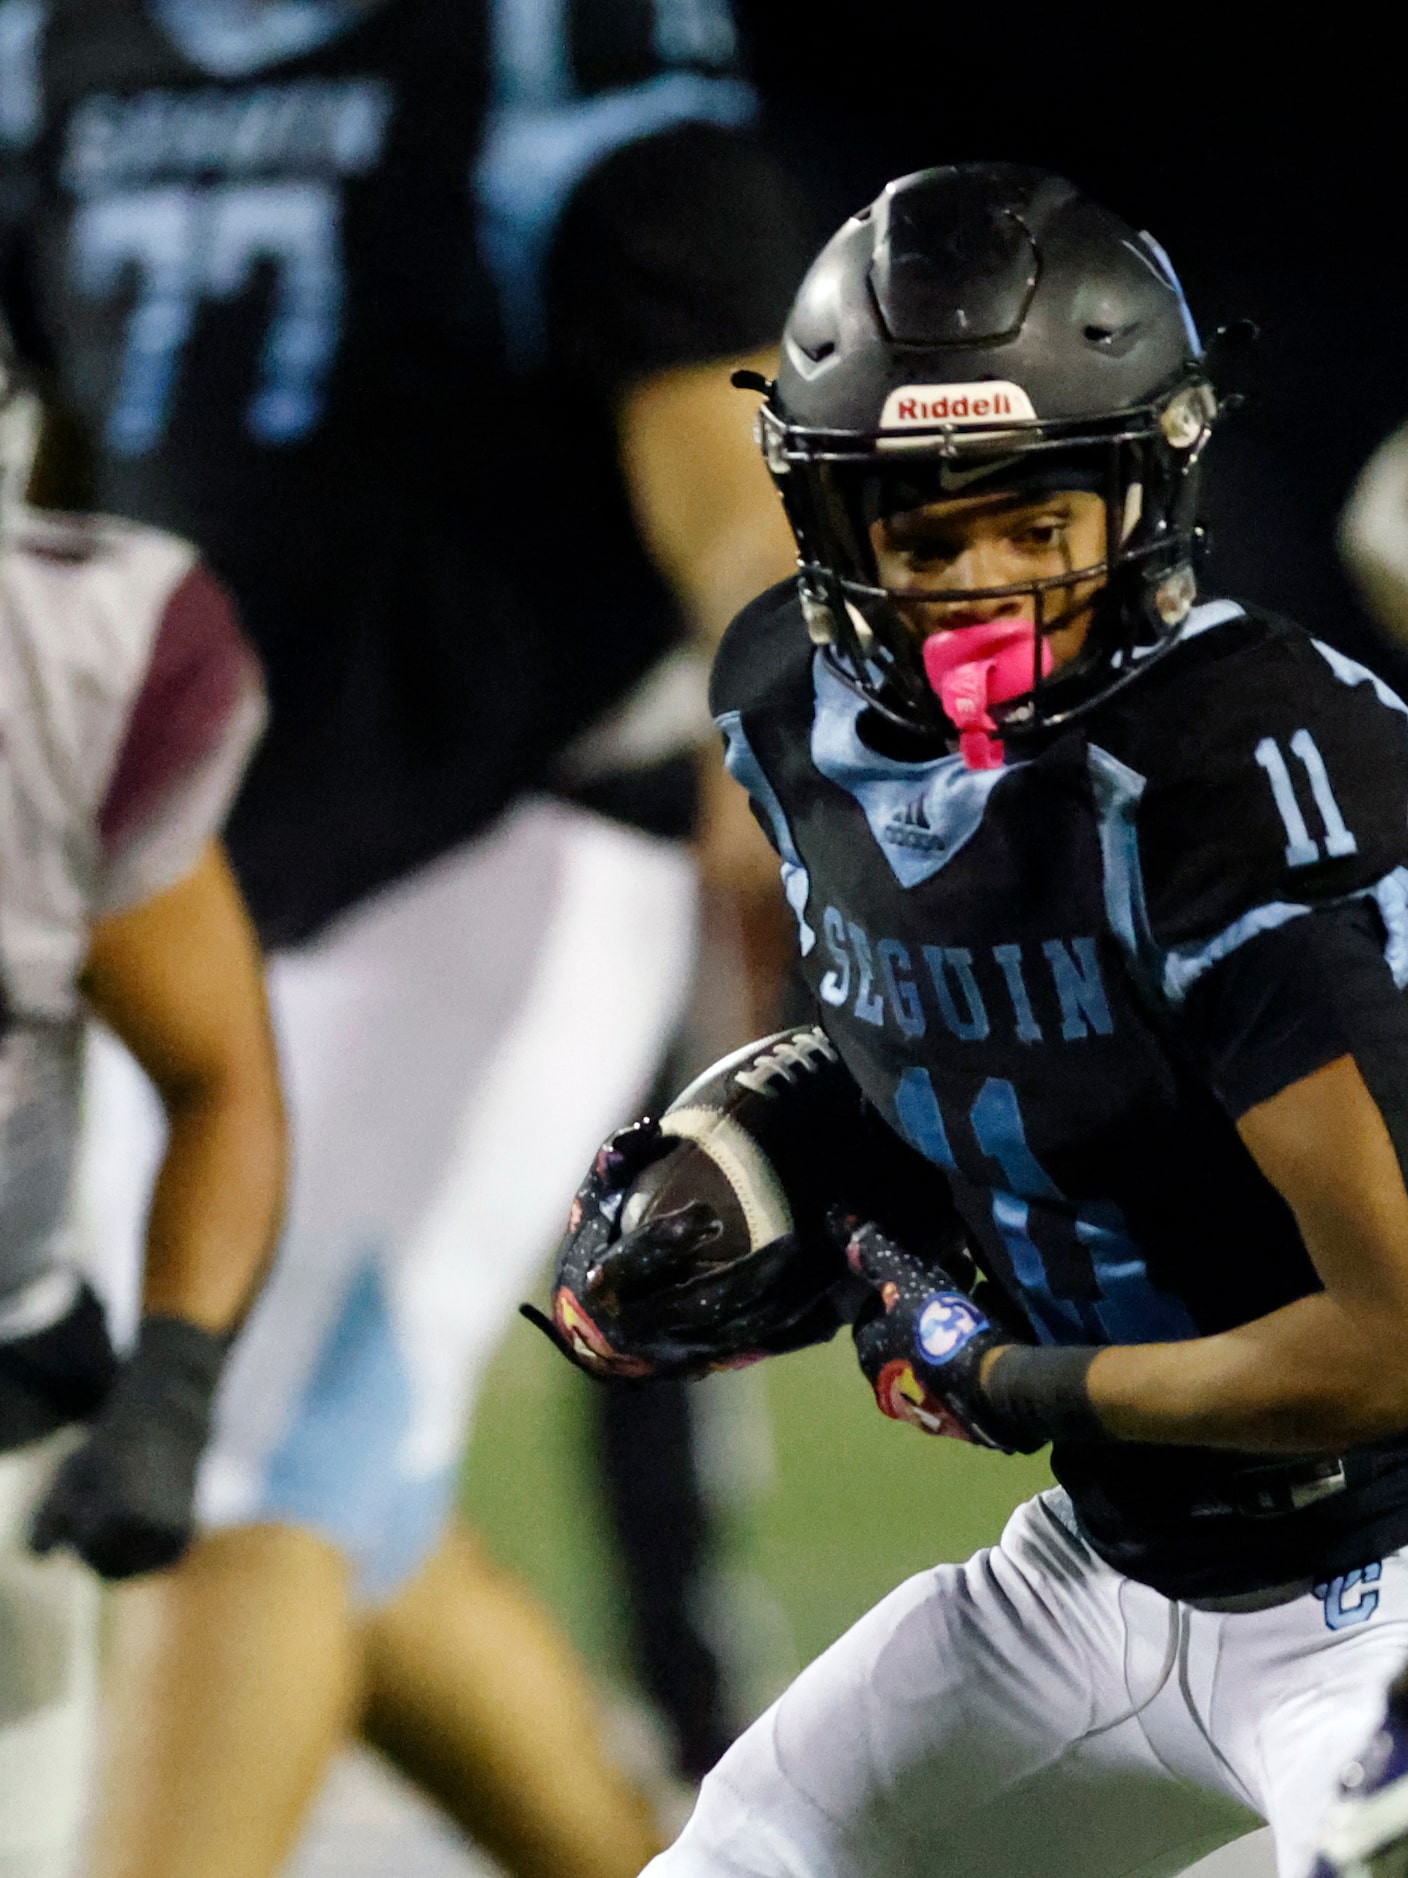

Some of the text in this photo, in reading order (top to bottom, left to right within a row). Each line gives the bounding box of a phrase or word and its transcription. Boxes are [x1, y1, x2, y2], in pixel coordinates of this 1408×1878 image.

[898, 393, 1012, 419] Riddell
[1254, 728, 1357, 867] 11
[820, 905, 1114, 1044] SEGUIN
[893, 1066, 1197, 1346] 11
